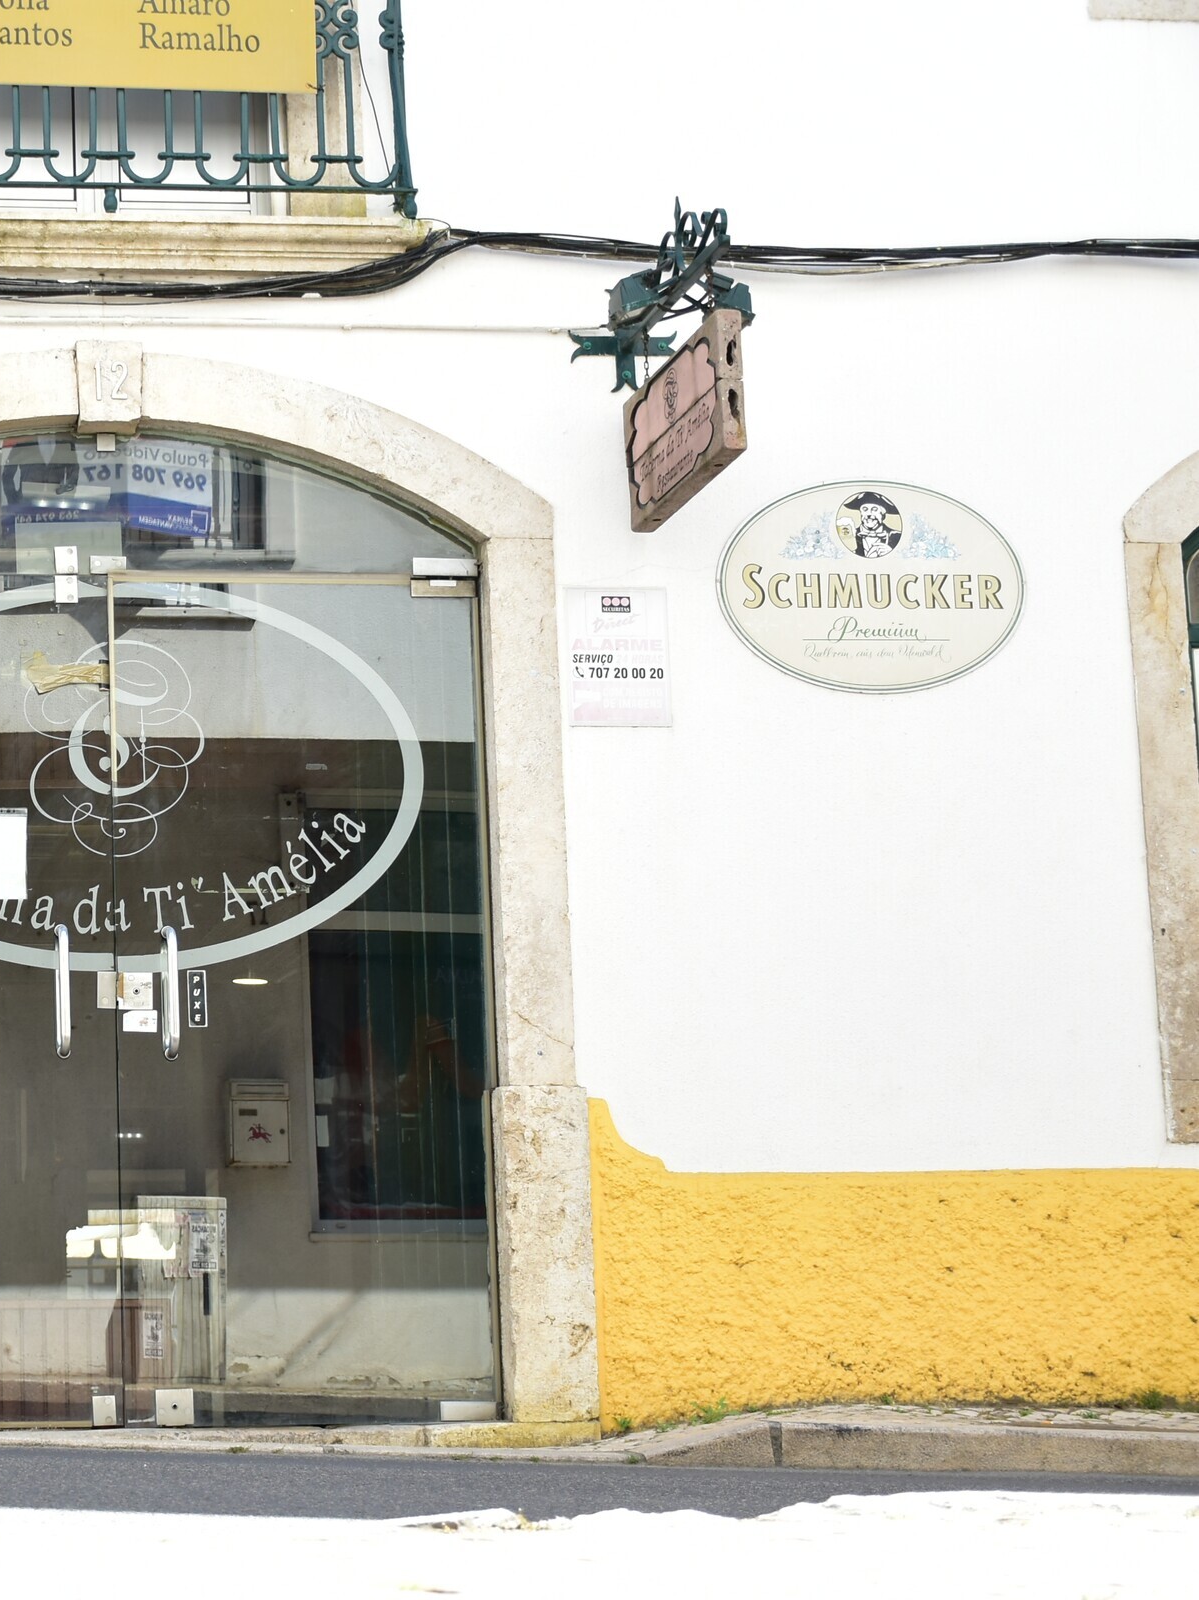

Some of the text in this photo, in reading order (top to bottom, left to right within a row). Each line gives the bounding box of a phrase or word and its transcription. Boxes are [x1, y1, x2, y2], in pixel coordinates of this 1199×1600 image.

[139, 22, 260, 53] Ramalho
[93, 360, 128, 401] 12
[742, 563, 1004, 610] SCHMUCKER
[571, 639, 664, 651] ALARME
[572, 653, 613, 666] SERVIÇO
[589, 667, 664, 679] 707 20 00 20
[222, 812, 366, 922] Amélia
[192, 975, 202, 1022] PUXE
